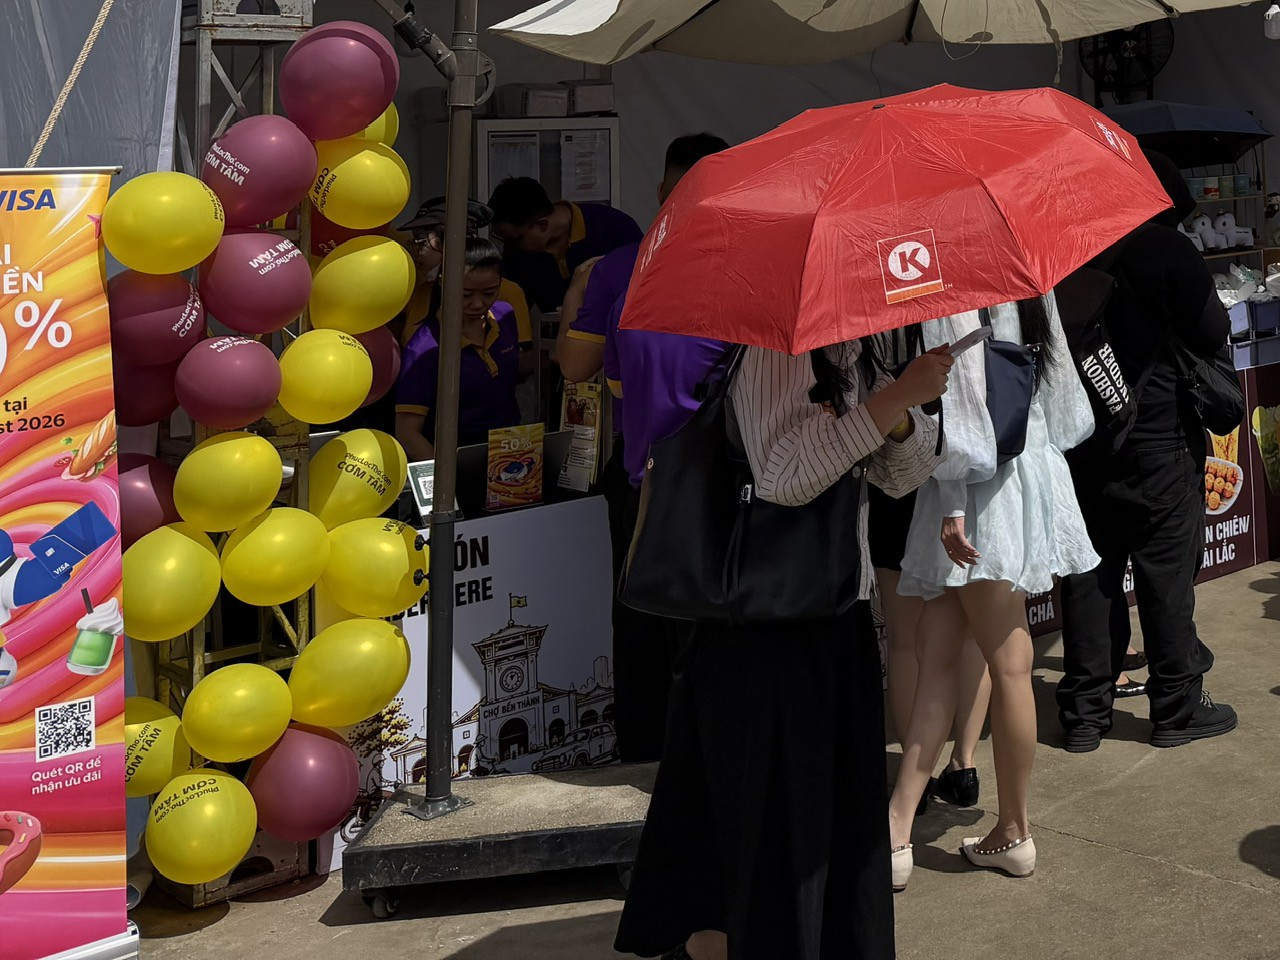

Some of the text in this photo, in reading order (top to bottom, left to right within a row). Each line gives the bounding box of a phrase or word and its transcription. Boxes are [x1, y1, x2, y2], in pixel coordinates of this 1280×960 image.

[220, 162, 245, 186] TẤM
[1081, 353, 1123, 416] FASHION
[3, 396, 27, 415] tại
[17, 413, 65, 432] 2026
[501, 437, 532, 452] 50%
[337, 460, 387, 496] CƠM TẤM
[454, 533, 489, 572] ÓN
[1200, 540, 1235, 569] ÀI LẮC
[53, 562, 70, 576] VISA
[455, 576, 493, 607] ERE
[1028, 594, 1055, 626] CHẢ
[483, 694, 541, 720] CHỢ BẾN THÀNH
[139, 727, 162, 752] TẤM
[31, 754, 102, 783] Quét QR để
[31, 770, 102, 795] nhận ưu đãi
[154, 778, 217, 816] CƠM TẤM
